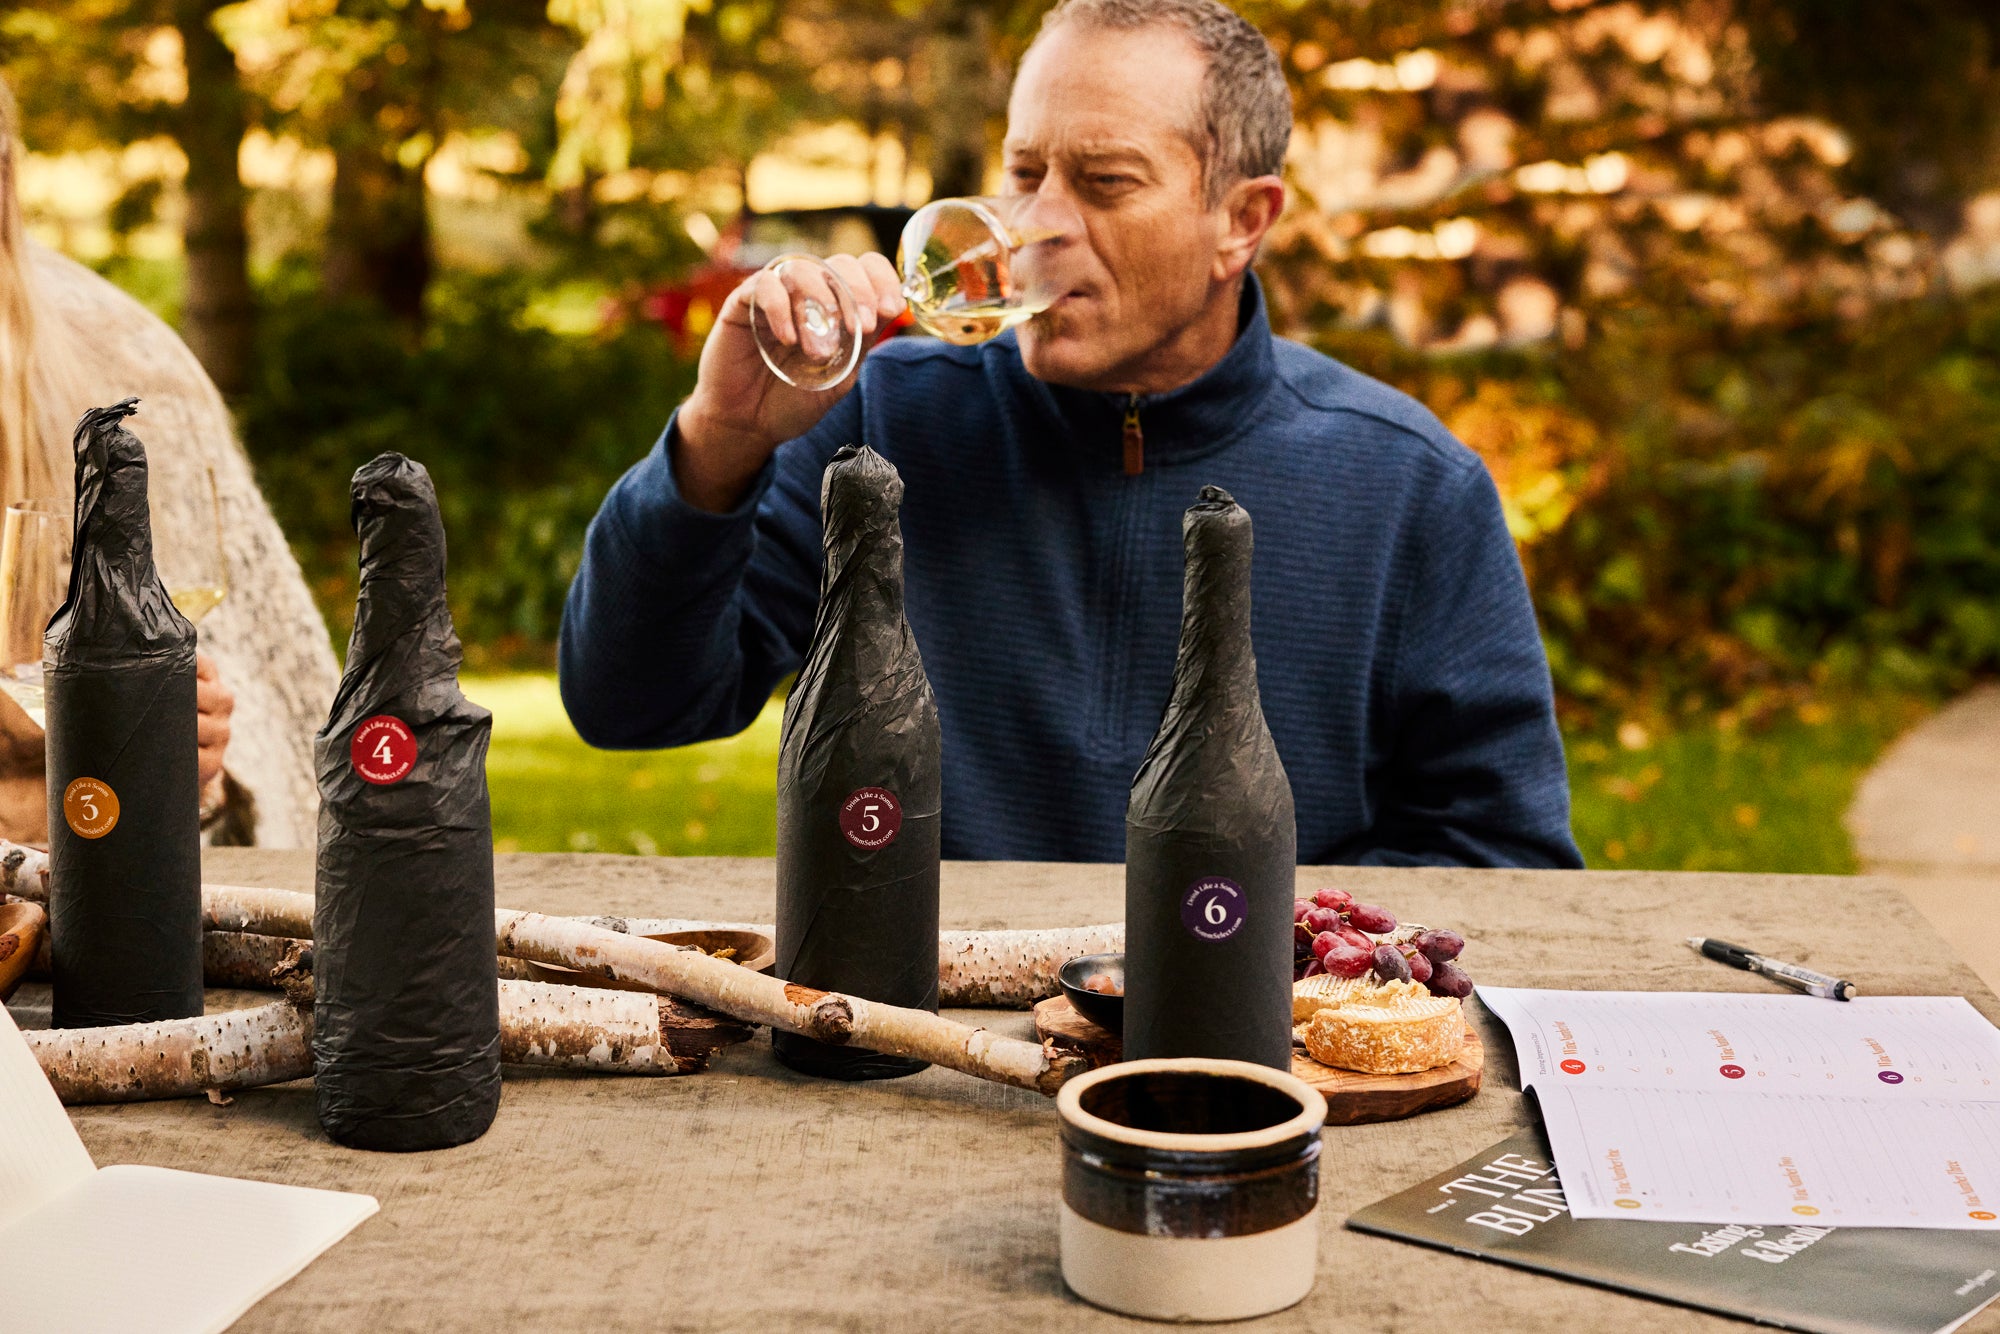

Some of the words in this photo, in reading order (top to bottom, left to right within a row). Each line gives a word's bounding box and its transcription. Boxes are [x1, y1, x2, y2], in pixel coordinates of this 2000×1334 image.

[372, 735, 394, 765] 4
[80, 794, 99, 821] 3
[845, 796, 860, 811] Drink
[860, 791, 874, 800] Like
[879, 793, 894, 810] Somm
[862, 805, 880, 832] 5
[847, 829, 894, 847] SommSelect.com
[1204, 895, 1227, 925] 6
[1438, 1153, 1557, 1198] THE
[1465, 1175, 1569, 1236] BLIN
